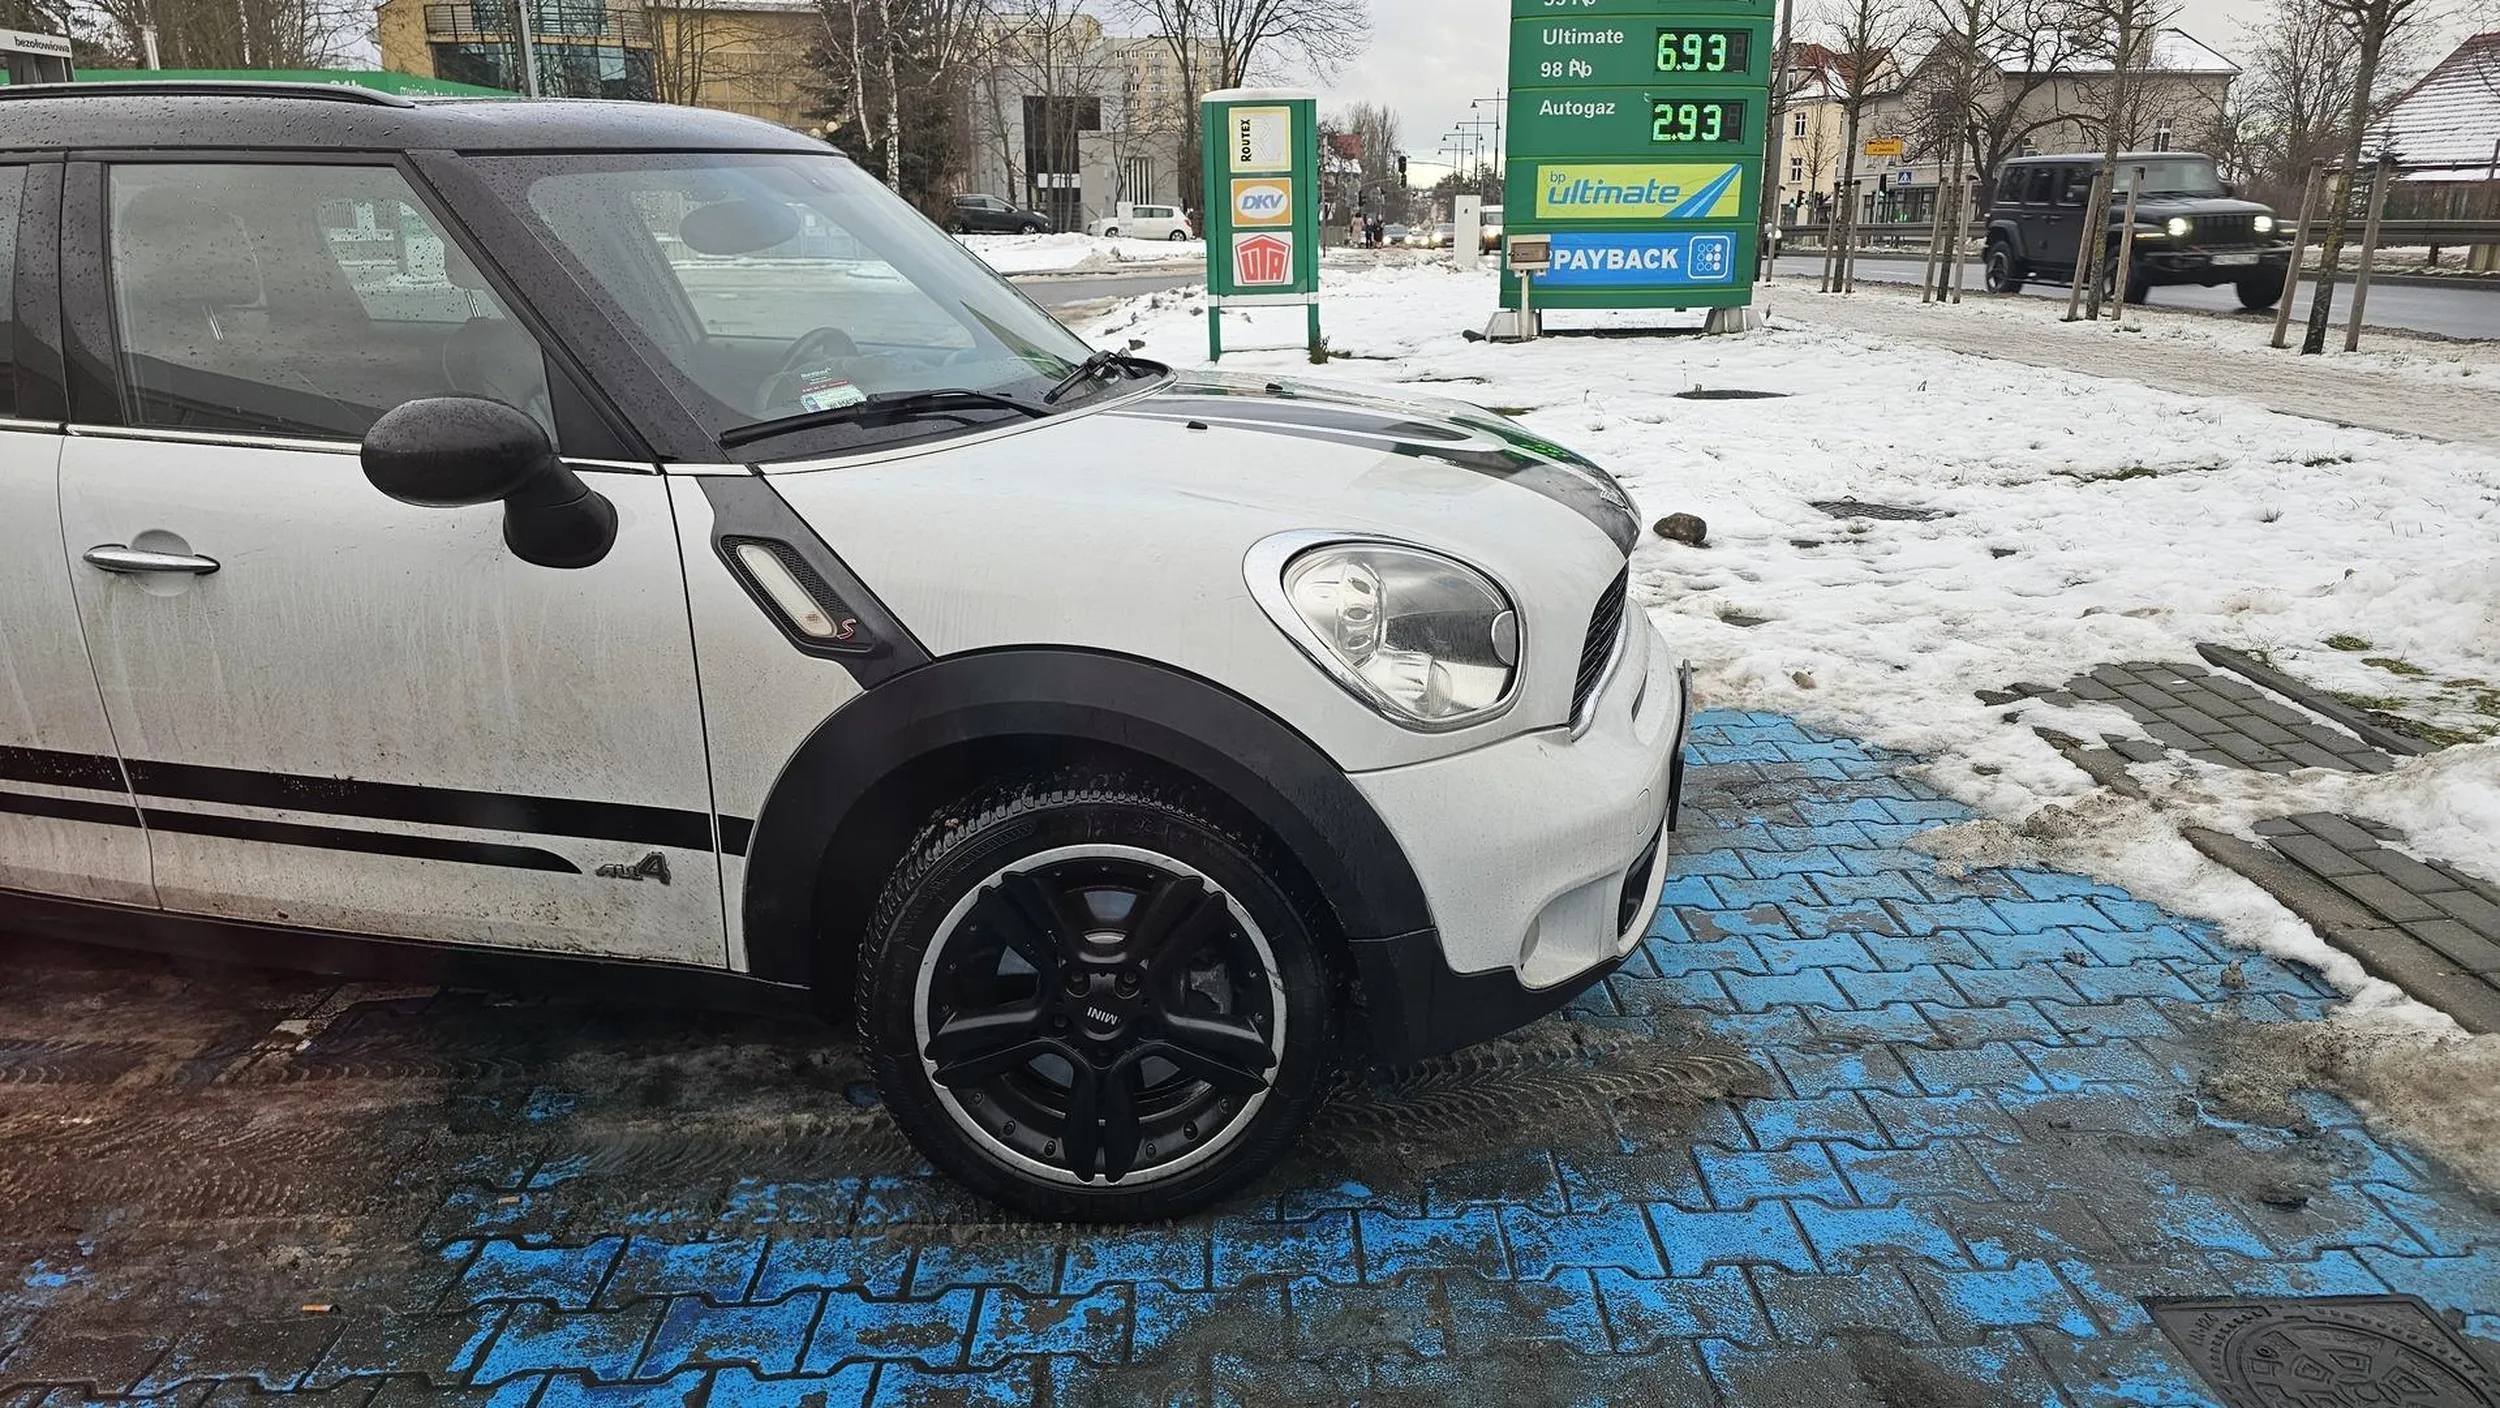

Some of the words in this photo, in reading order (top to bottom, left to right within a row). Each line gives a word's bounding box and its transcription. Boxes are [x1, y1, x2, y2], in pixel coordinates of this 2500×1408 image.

[1542, 28, 1625, 45] Ultimate
[1657, 32, 1727, 72] 6.93
[1540, 62, 1563, 78] 98
[1539, 99, 1616, 119] Autogaz
[1652, 103, 1722, 142] 2.93
[1240, 118, 1252, 162] ROUTEX
[1550, 170, 1566, 184] bp
[1241, 194, 1284, 211] DKV
[1548, 178, 1681, 205] ultimate
[1237, 236, 1290, 282] UTA
[1554, 247, 1680, 271] PAYBACK
[836, 618, 857, 641] S
[1086, 1006, 1119, 1026] MINI
